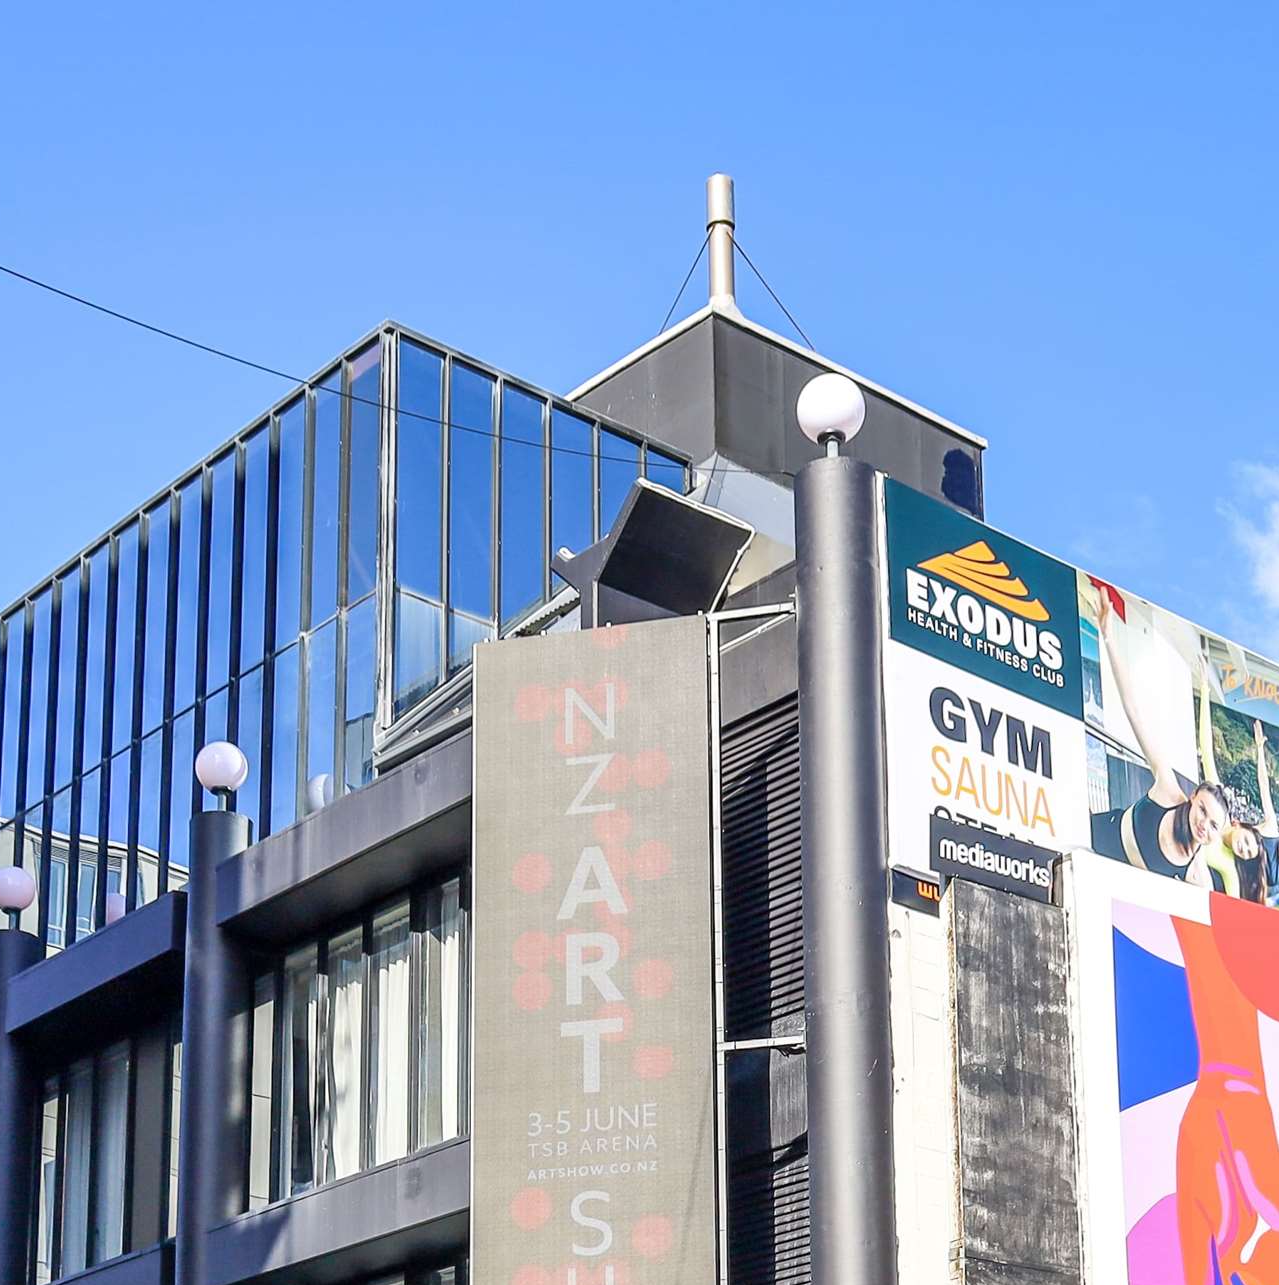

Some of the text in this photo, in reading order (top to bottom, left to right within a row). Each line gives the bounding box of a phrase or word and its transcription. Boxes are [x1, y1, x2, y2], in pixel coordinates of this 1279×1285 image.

[906, 567, 1064, 670] EXODUS
[907, 608, 1065, 688] HEALTH & FITNESS CLUB
[928, 686, 1053, 780] GYM
[930, 745, 1056, 837] SAUNA
[556, 681, 629, 1093] NZ ART
[938, 837, 1051, 888] mediaworks
[527, 1102, 657, 1137] 3-5 JUNE
[528, 1134, 657, 1158] TSB ARENA
[528, 1160, 657, 1181] ARTSHOW.CO.NZ
